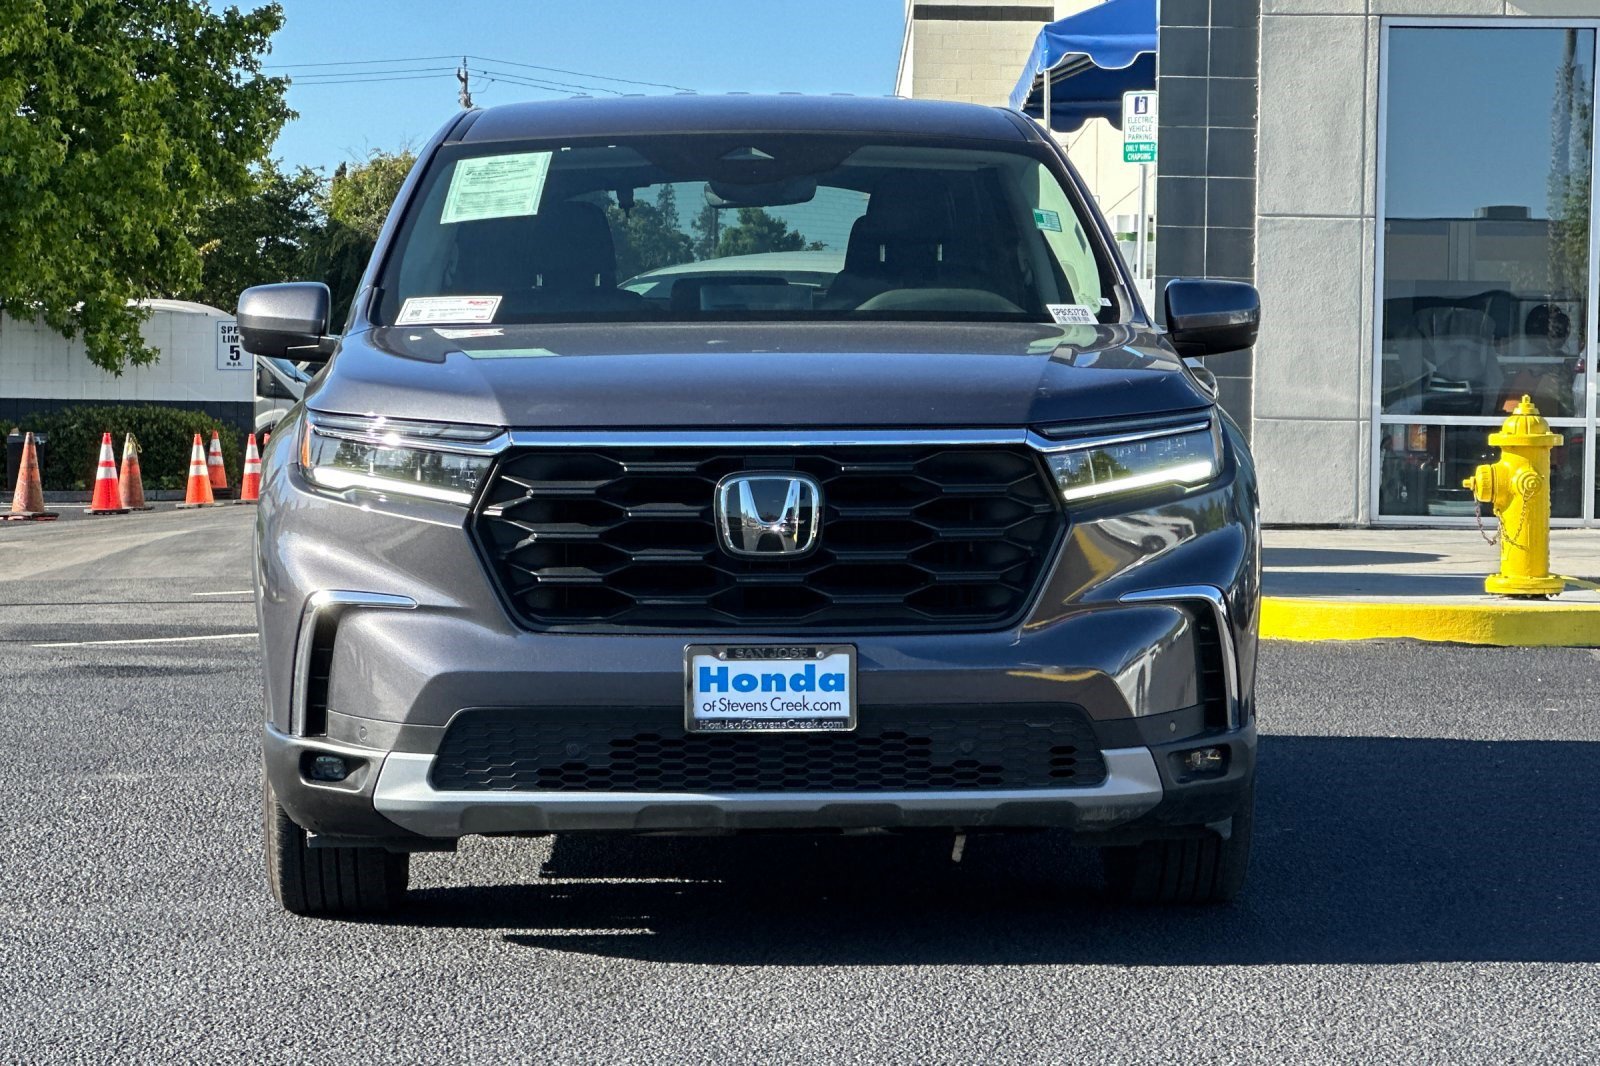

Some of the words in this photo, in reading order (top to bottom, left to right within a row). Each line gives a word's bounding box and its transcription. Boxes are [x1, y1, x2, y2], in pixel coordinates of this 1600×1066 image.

[1127, 116, 1154, 124] ELECTRIC
[1125, 144, 1138, 152] ONLY
[1140, 144, 1155, 152] WHILE
[221, 325, 239, 334] SPE
[222, 335, 239, 343] LIM
[230, 345, 240, 361] 5
[735, 648, 766, 658] SAN
[770, 648, 809, 658] JOSE
[699, 664, 845, 692] Honda
[702, 700, 716, 712] of
[719, 697, 768, 712] Stevens
[770, 695, 841, 712] Creek.com
